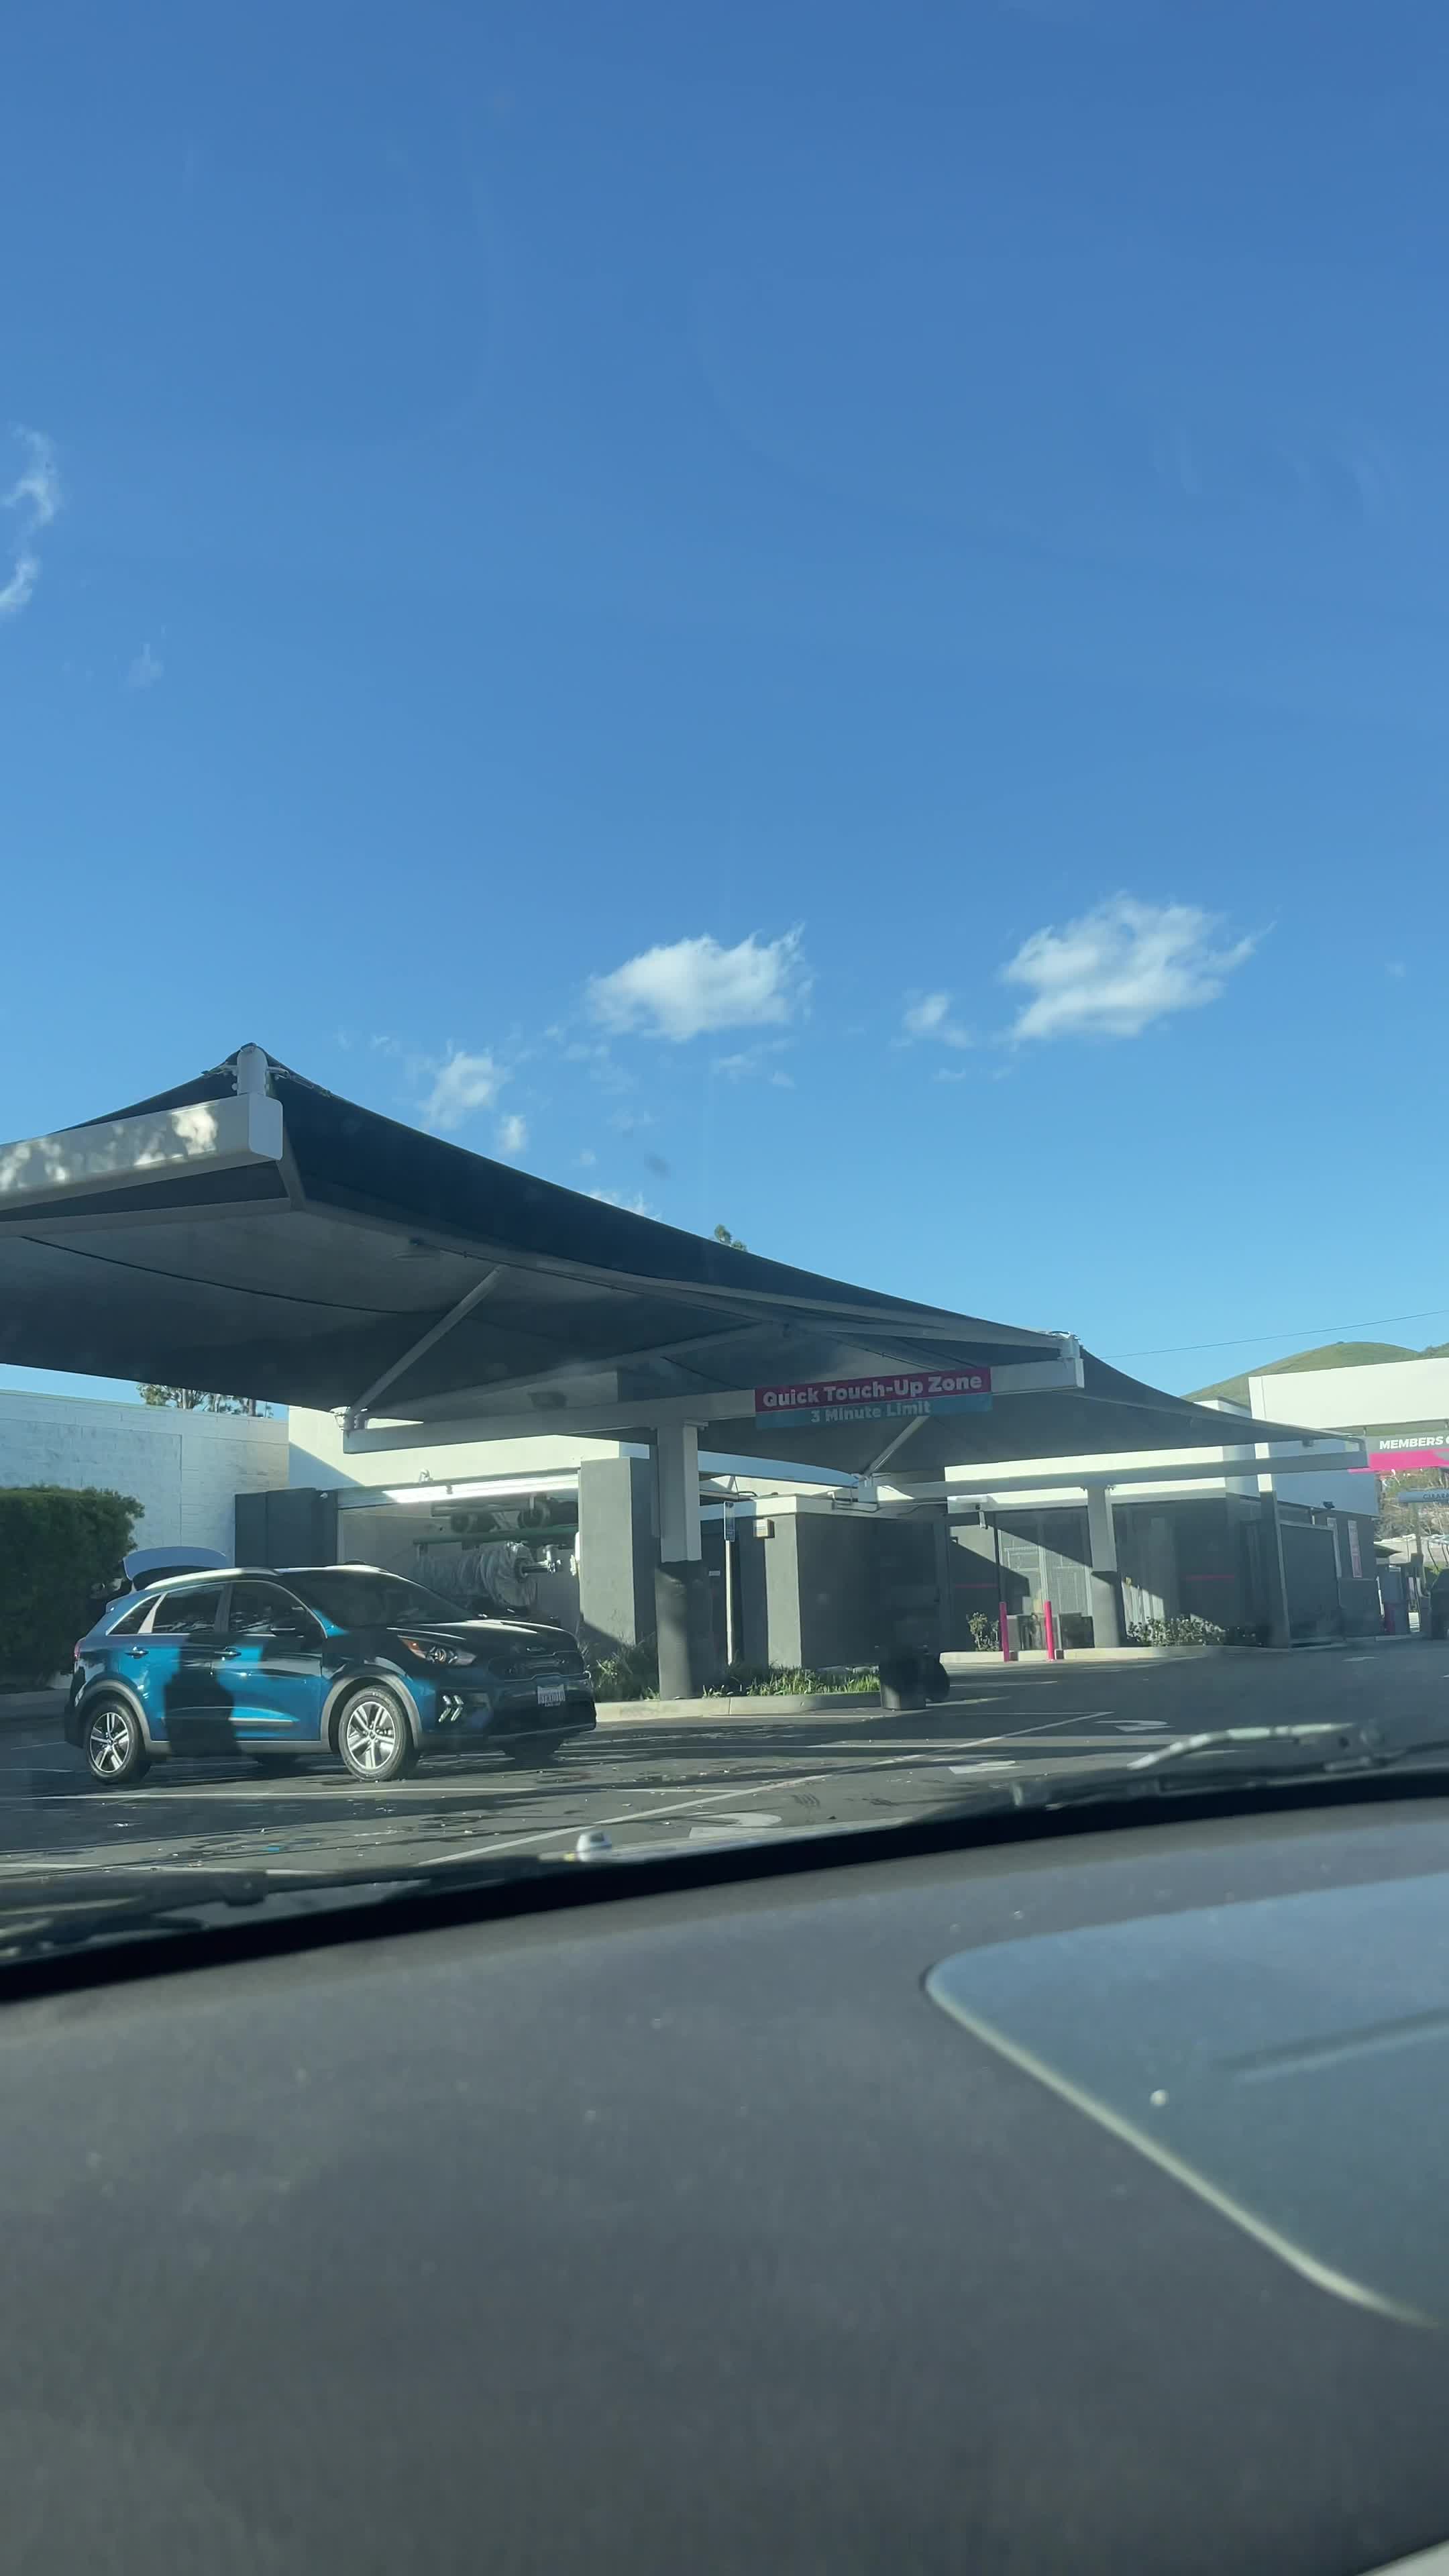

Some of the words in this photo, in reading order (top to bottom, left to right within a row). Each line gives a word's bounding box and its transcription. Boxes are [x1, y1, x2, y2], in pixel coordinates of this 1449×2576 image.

[763, 1387, 819, 1407] Quick
[824, 1379, 923, 1401] Touch-Up
[928, 1375, 983, 1393] Zone
[811, 1410, 820, 1423] 3
[825, 1405, 881, 1421] Minute
[886, 1401, 931, 1417] Limit
[1379, 1436, 1444, 1450] MEMBERS
